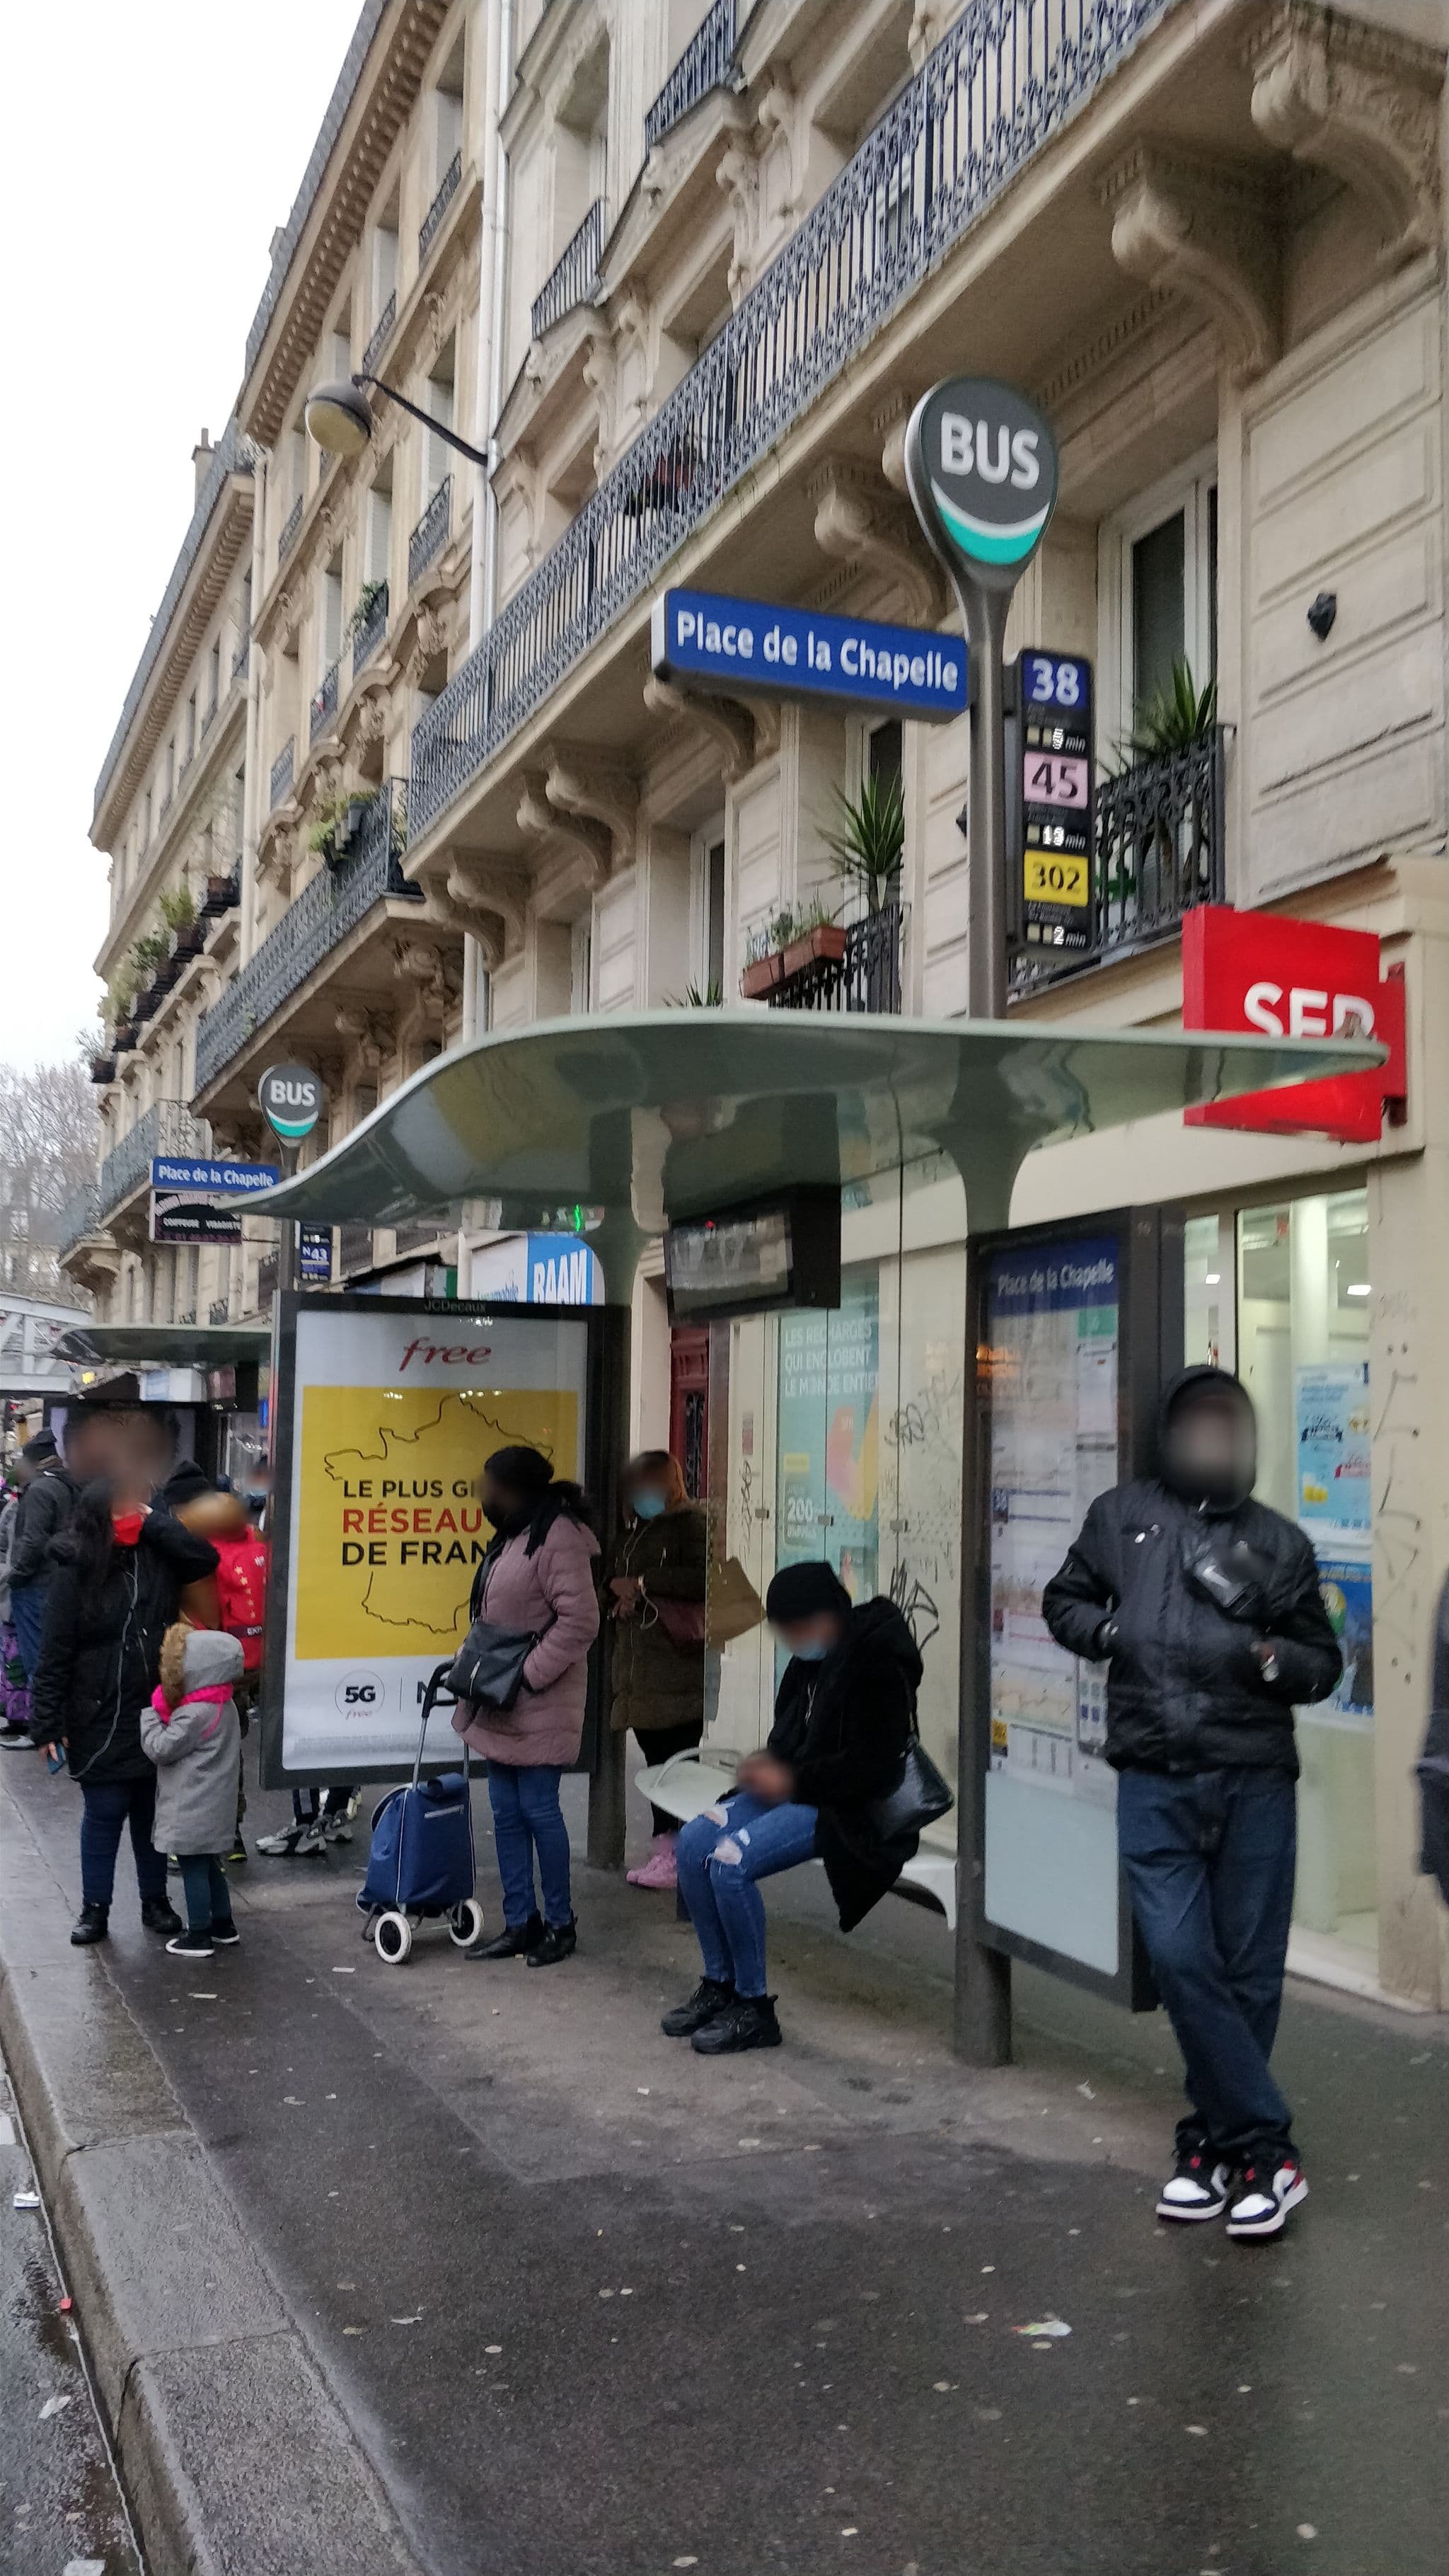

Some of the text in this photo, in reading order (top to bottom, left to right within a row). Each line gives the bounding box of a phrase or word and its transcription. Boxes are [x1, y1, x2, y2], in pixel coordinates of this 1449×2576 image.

[941, 411, 1039, 490] BUS
[677, 610, 958, 692] Place de la Chapelle
[1032, 658, 1080, 706] 38
[1032, 759, 1078, 798] 45
[1032, 861, 1081, 895] 302
[271, 1079, 316, 1107] BUS
[158, 1165, 274, 1188] Place de la Chapelle
[424, 1299, 486, 1314] JCDecaux
[399, 1336, 492, 1372] free
[343, 1479, 373, 1498] LE
[382, 1479, 443, 1498] PLUS
[342, 1502, 482, 1534] RÉSEAU
[342, 1540, 387, 1566] DE
[345, 1685, 376, 1703] 5G
